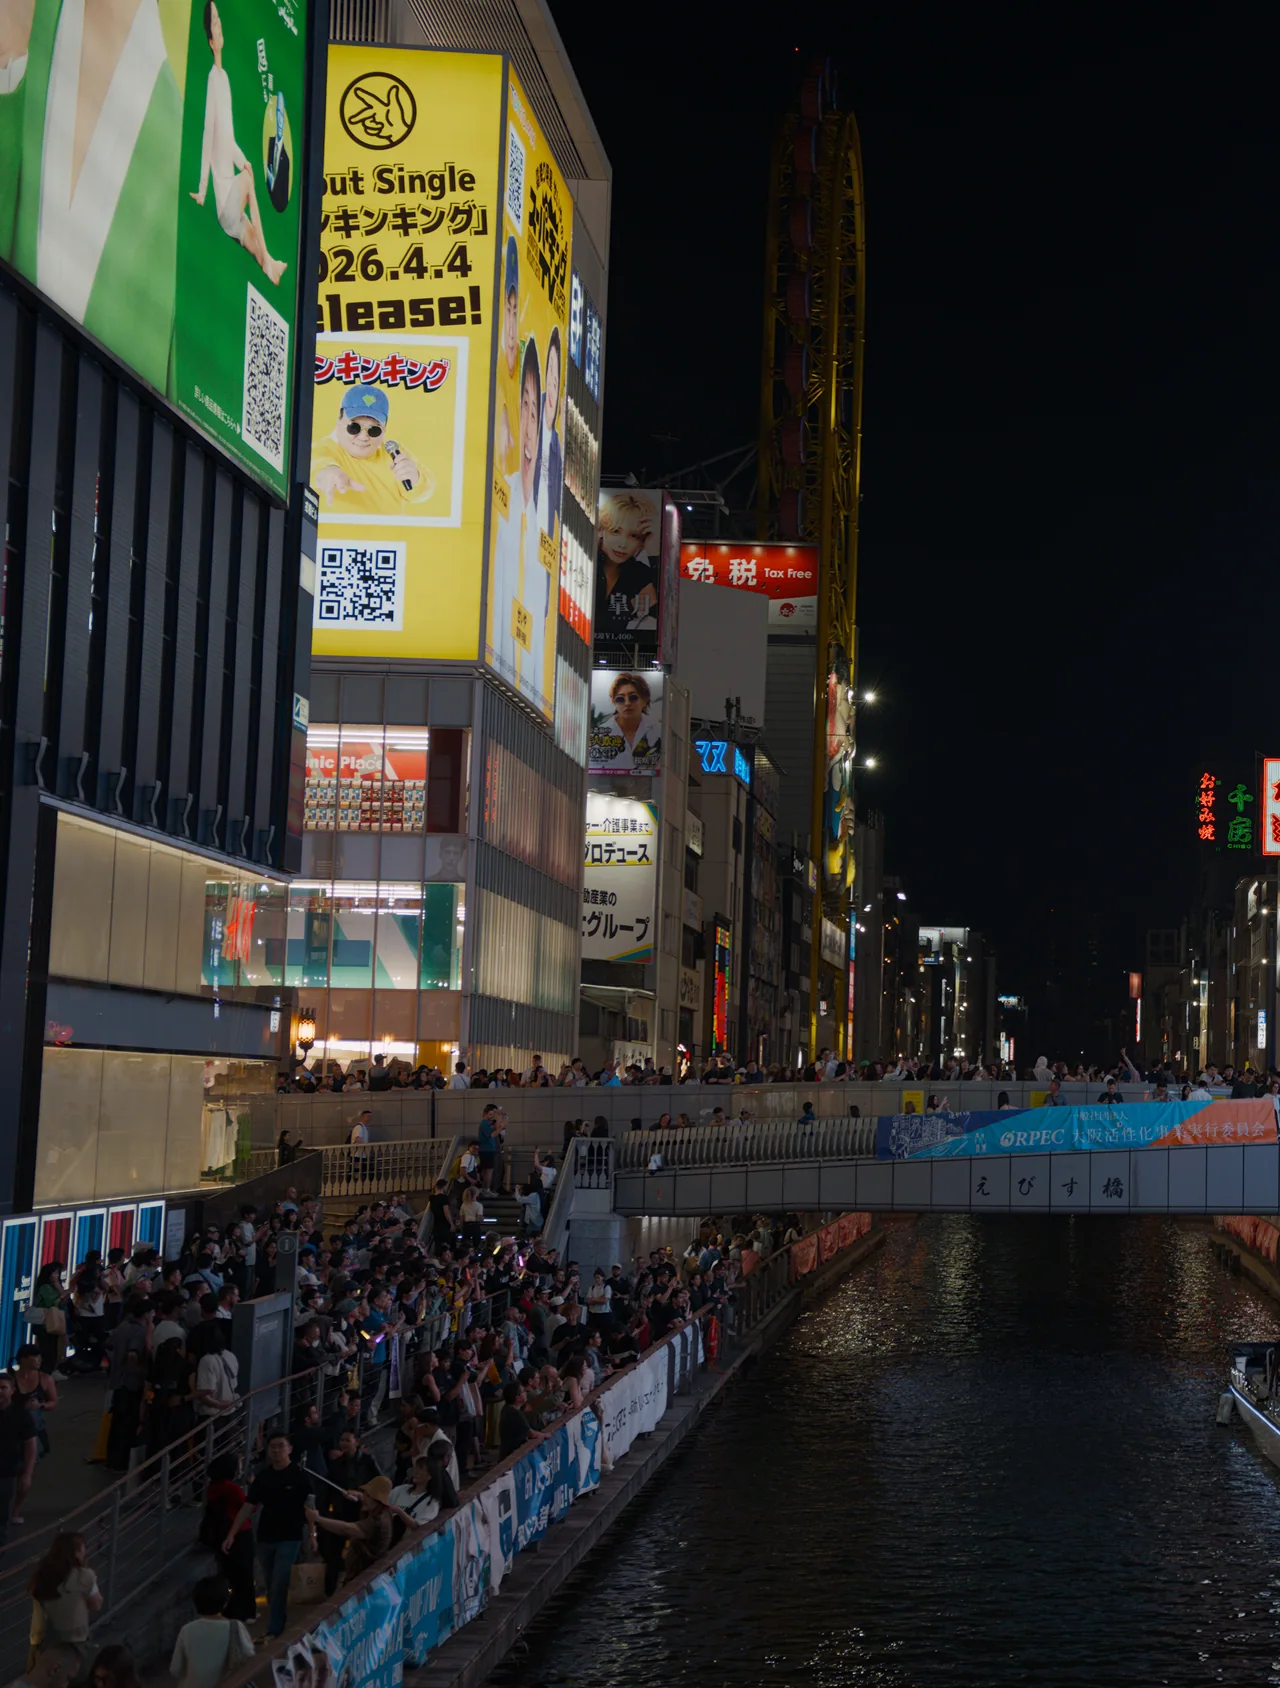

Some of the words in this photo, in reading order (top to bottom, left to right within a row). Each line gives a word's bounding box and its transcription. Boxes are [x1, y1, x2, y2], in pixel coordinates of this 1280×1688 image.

[373, 162, 476, 200] Single
[687, 557, 757, 586] 免税
[764, 568, 784, 578] Tax
[787, 568, 812, 579] Free
[1198, 772, 1215, 840] お好み焼
[1071, 1123, 1265, 1146] 大阪活性化事業実行委員会
[976, 1175, 1124, 1200] えびす橋
